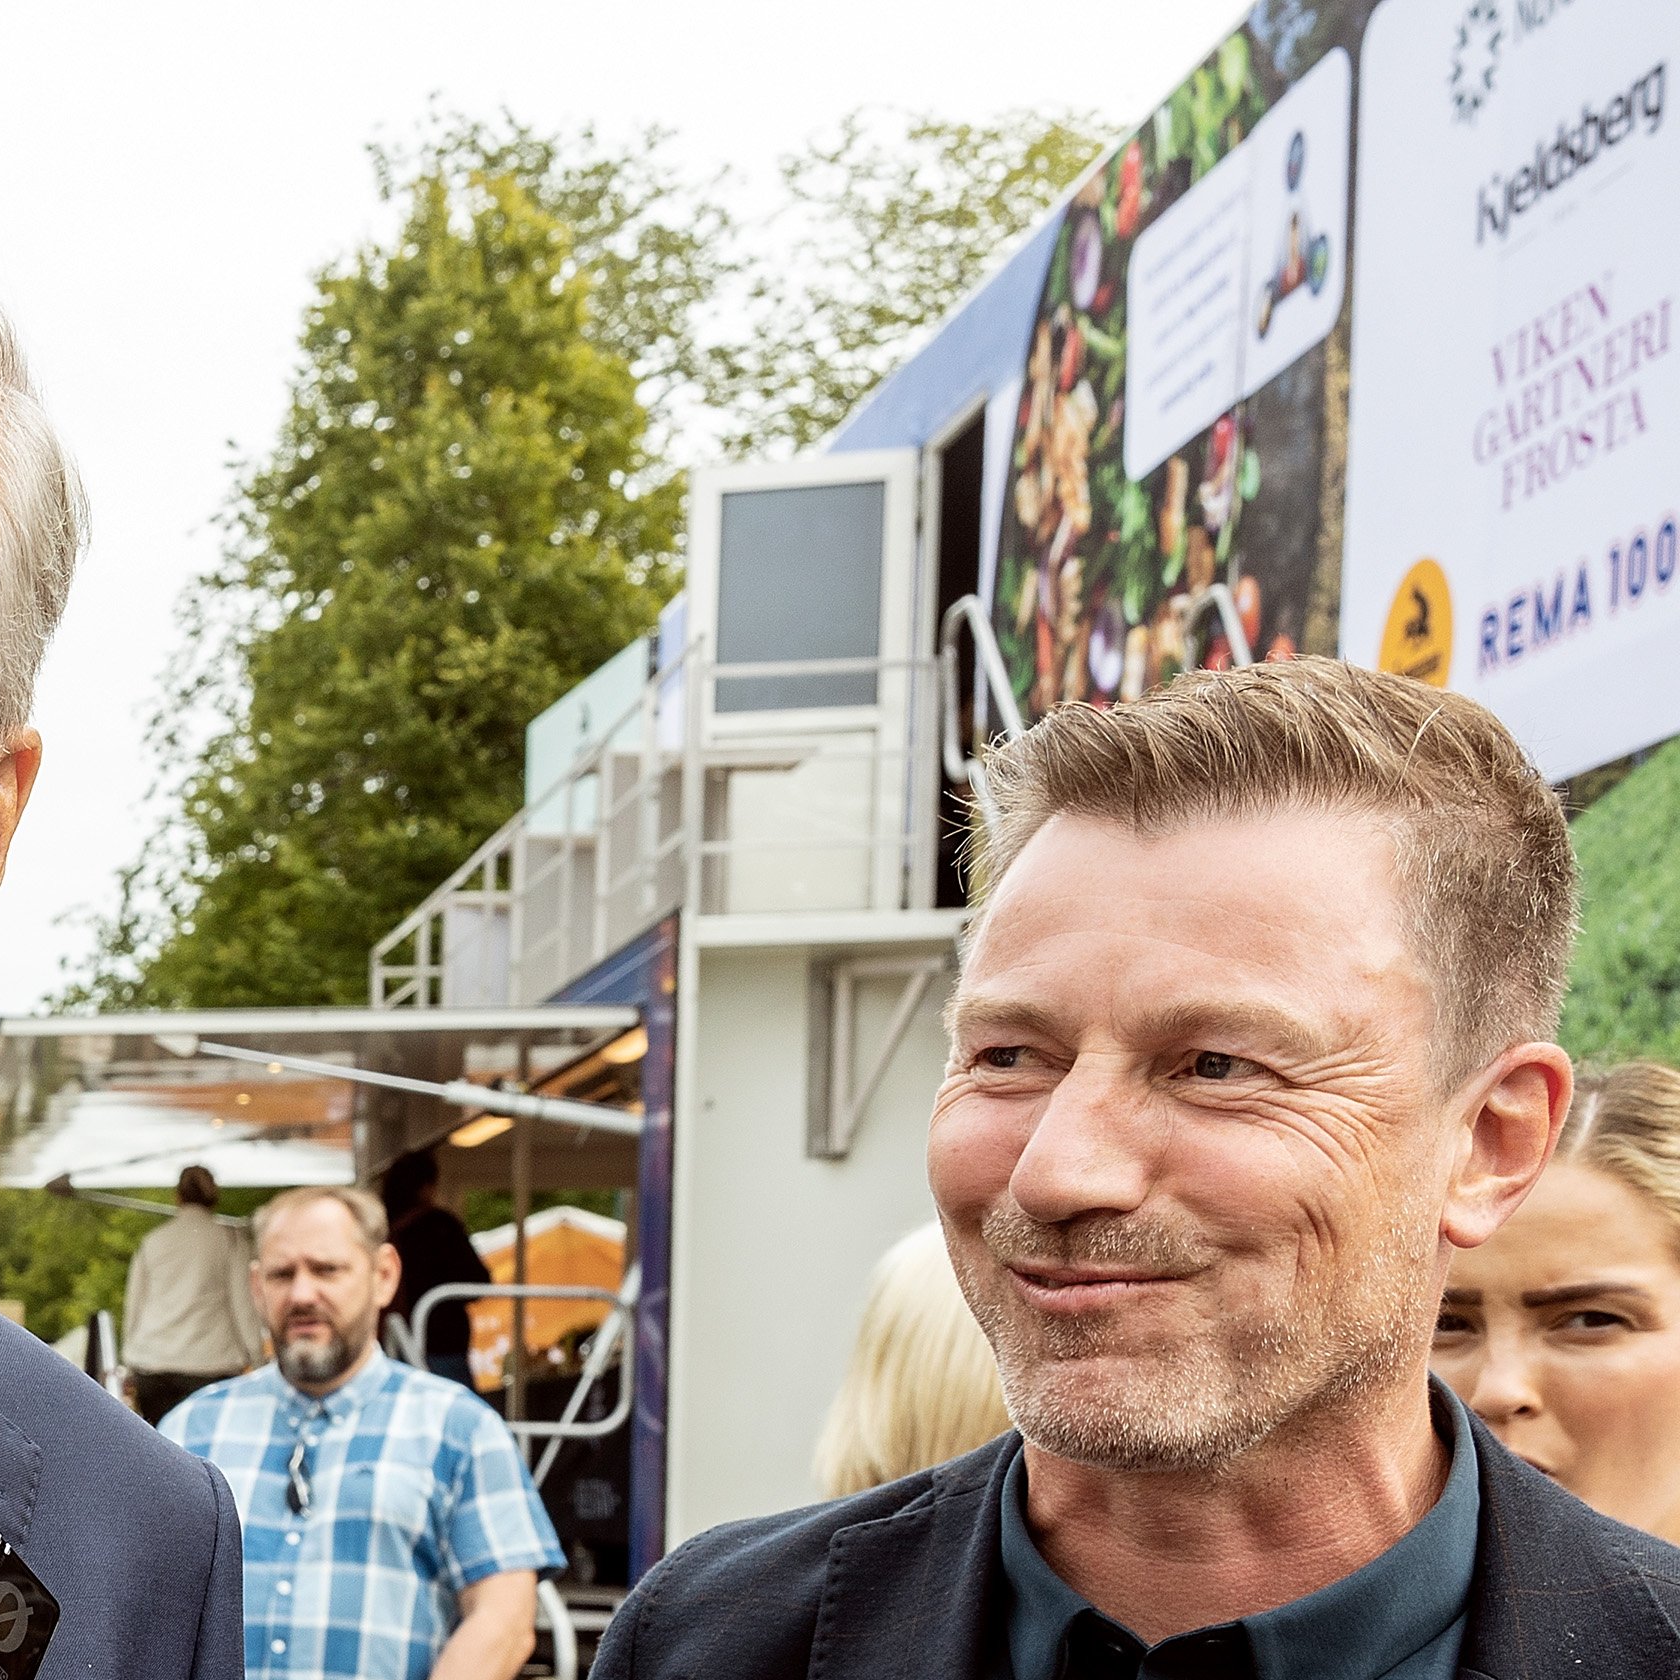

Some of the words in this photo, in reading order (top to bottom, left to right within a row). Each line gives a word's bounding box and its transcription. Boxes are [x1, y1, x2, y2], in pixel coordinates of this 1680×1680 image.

[1473, 298, 1670, 465] GARTNERI
[1492, 270, 1613, 386] VIKEN
[1502, 388, 1646, 511] FROSTA
[1478, 562, 1591, 676] REMA
